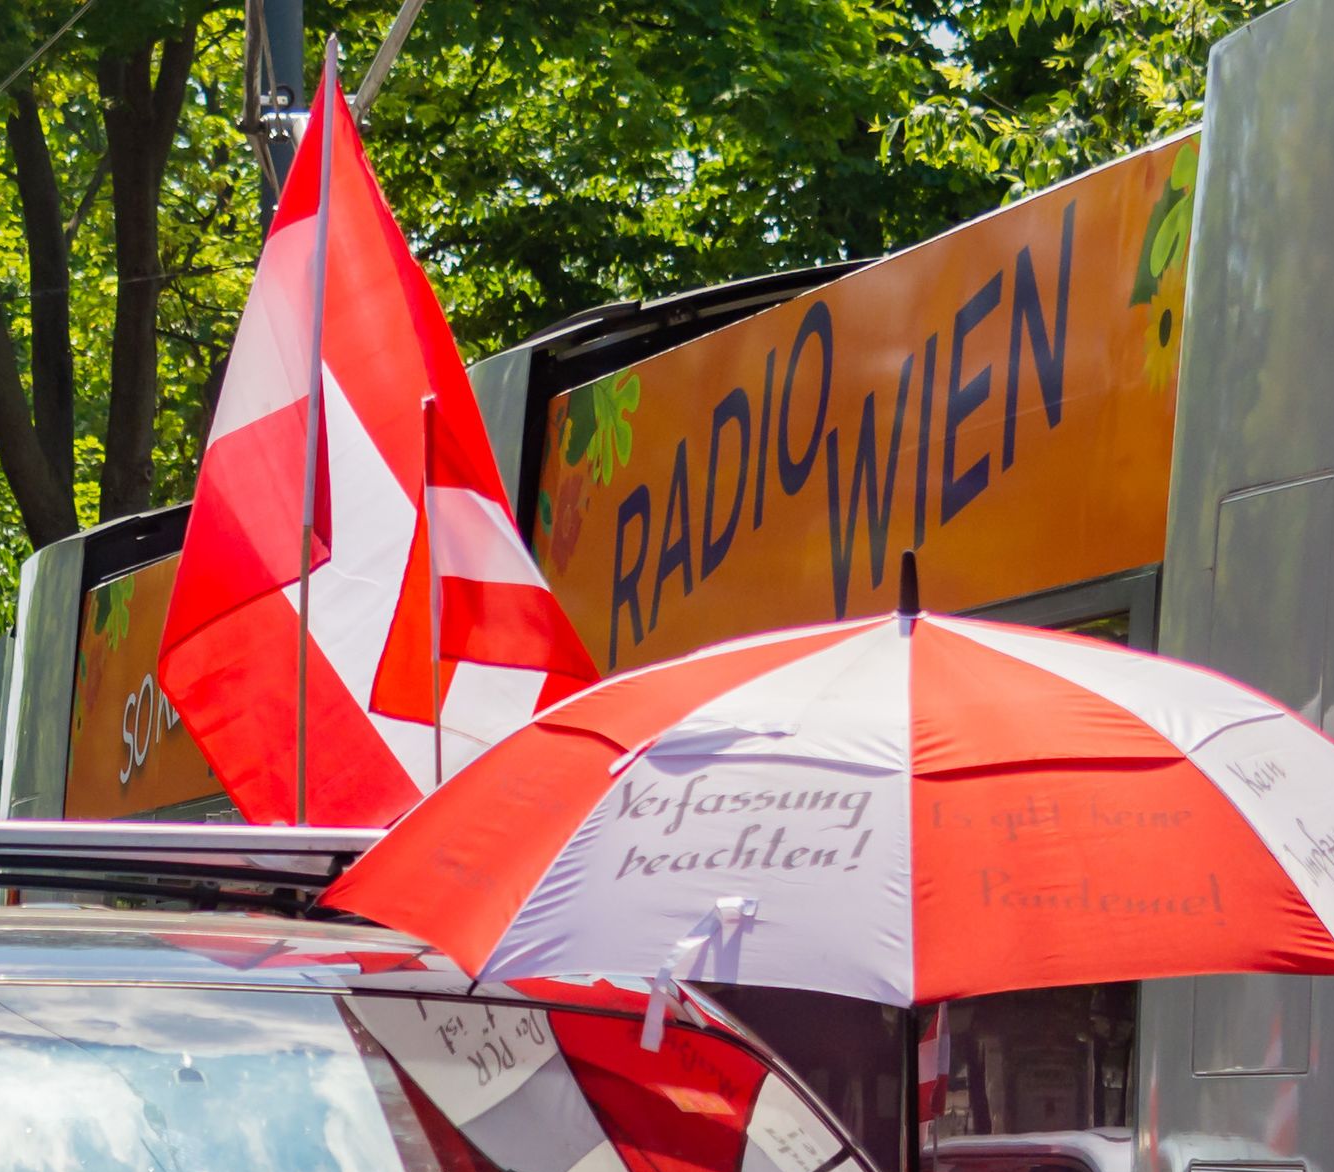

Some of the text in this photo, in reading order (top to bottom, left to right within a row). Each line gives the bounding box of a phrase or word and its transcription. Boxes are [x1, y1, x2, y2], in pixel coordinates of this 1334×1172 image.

[826, 199, 1076, 622] WIEN
[609, 300, 834, 672] RADIO
[120, 672, 154, 784] SO
[615, 824, 874, 881] beachten!
[617, 774, 873, 836] Verfassung
